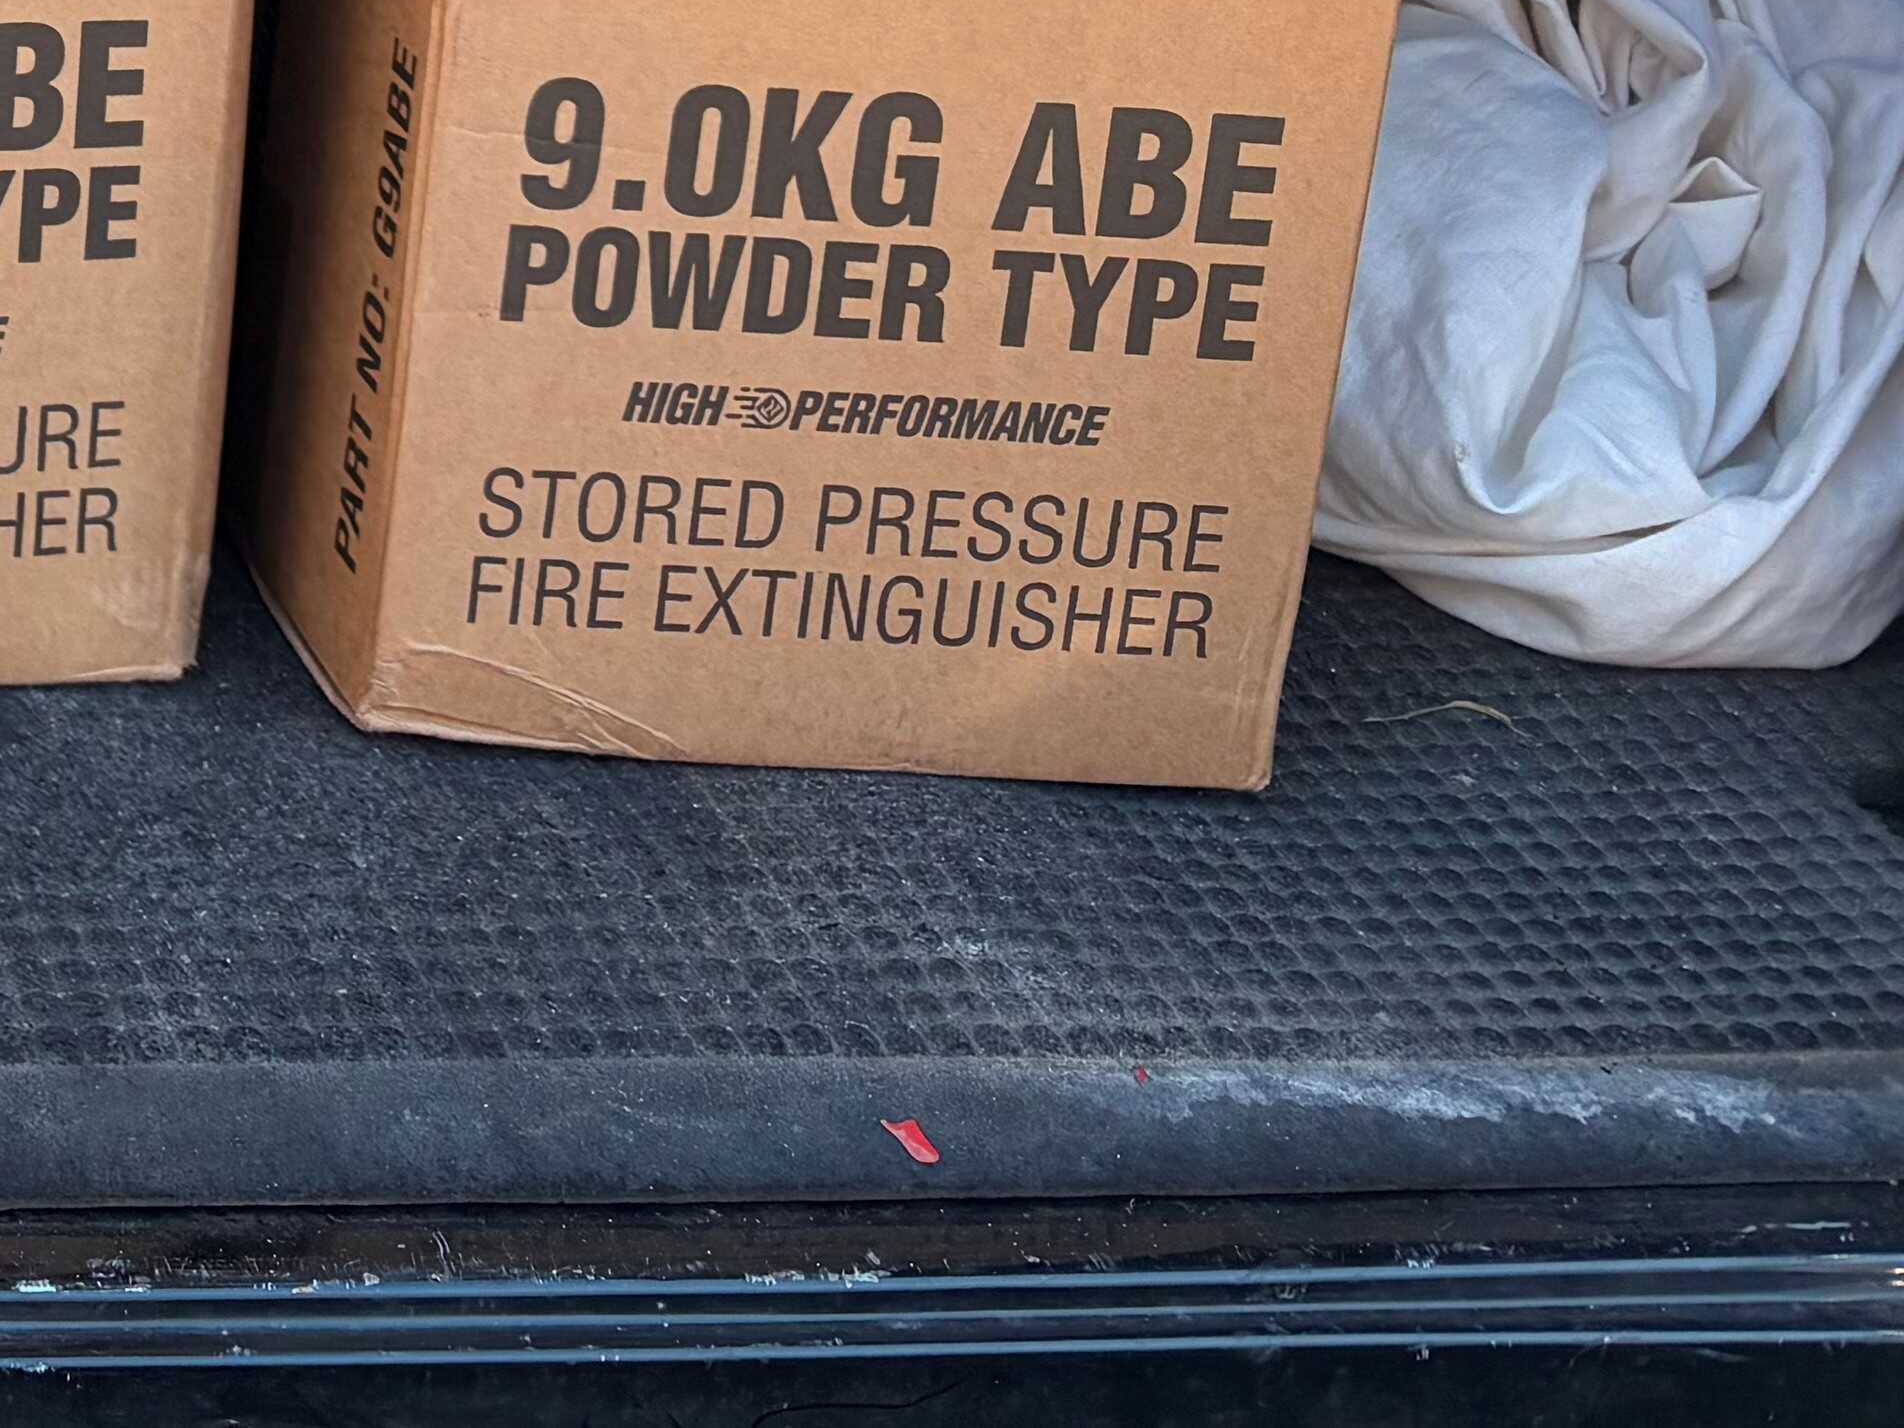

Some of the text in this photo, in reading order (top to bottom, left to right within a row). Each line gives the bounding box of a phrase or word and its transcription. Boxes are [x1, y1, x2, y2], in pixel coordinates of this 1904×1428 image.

[521, 77, 1285, 245] 9.0KG ABE
[333, 35, 418, 574] PART NO: G9ABE
[500, 225, 1265, 361] POWDER TYPE
[622, 382, 1110, 446] HIGH PERFORMANCE
[479, 467, 1229, 573] STORED PRESSURE
[467, 556, 1214, 658] FIRE EXTINGUISHER
